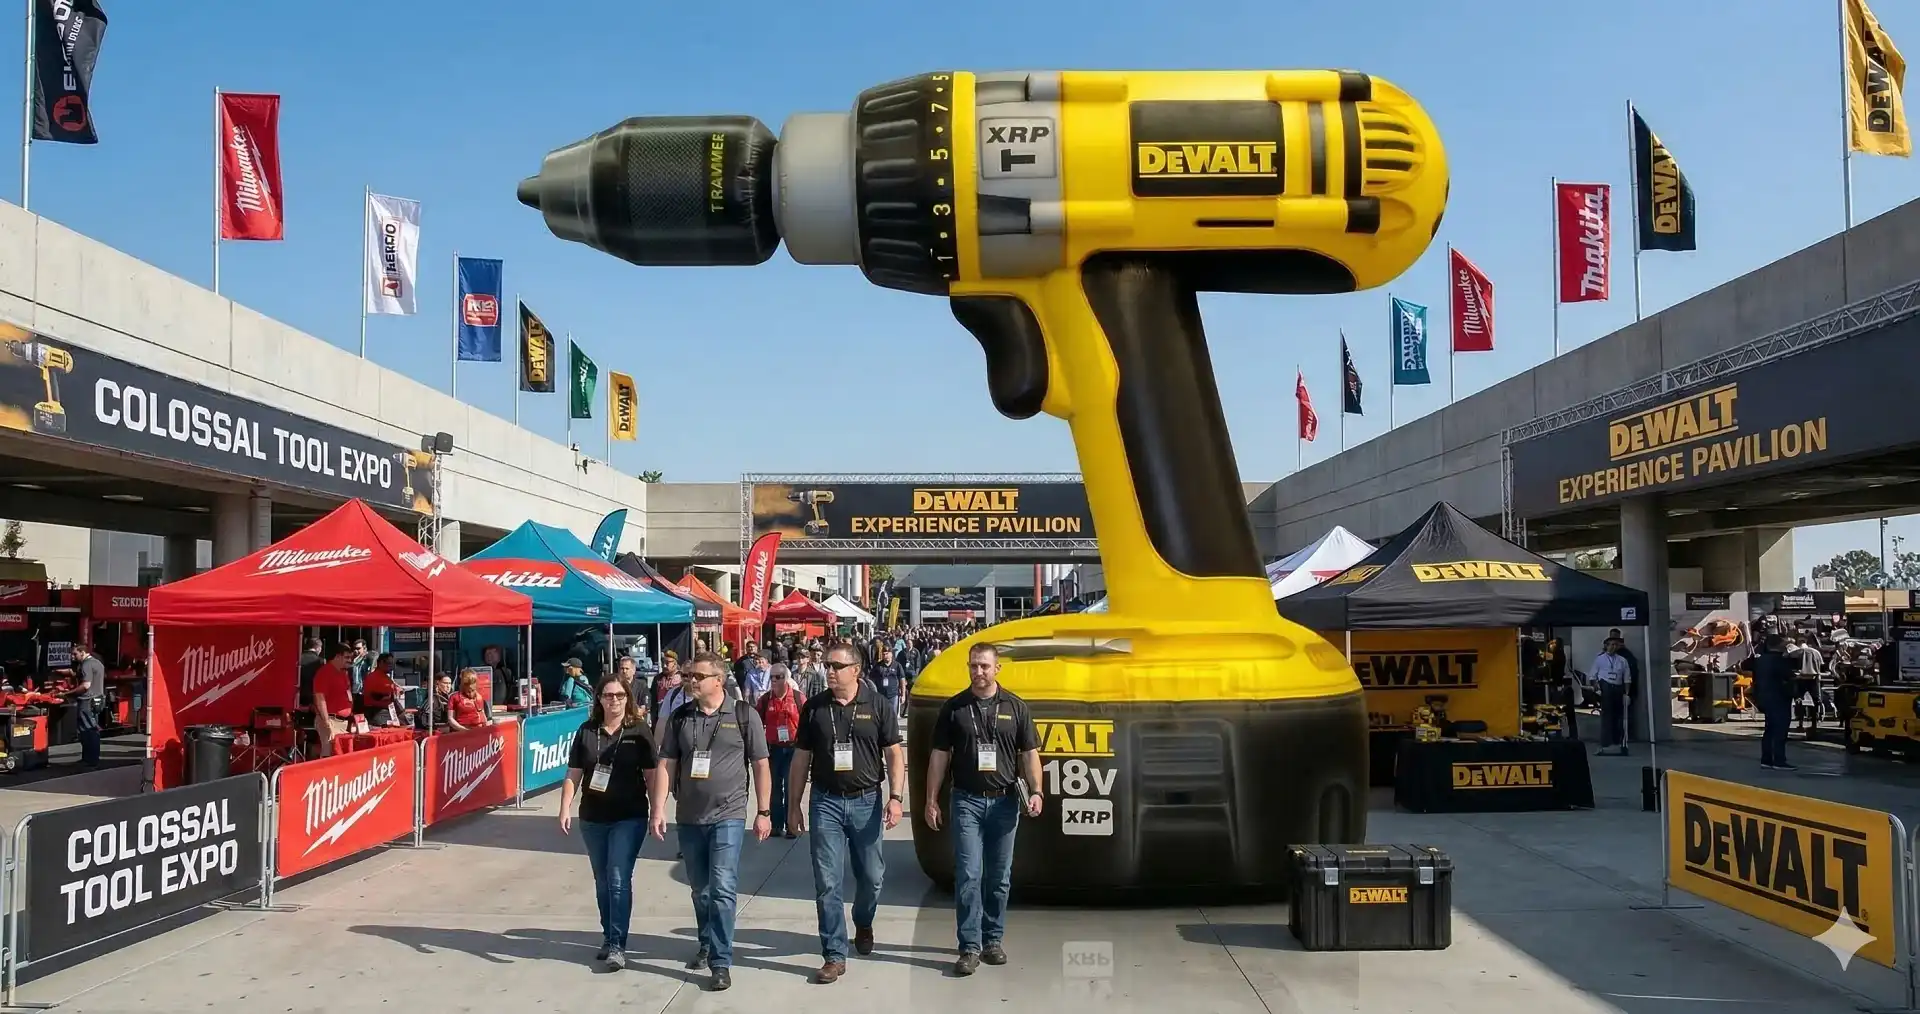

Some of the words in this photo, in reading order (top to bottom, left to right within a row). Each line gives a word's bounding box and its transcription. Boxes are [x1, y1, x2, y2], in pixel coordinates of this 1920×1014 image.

[931, 102, 949, 113] 7
[986, 126, 1050, 143] XRP
[229, 124, 264, 206] Milwaukee
[931, 148, 949, 160] 5
[933, 203, 951, 216] 3
[1458, 268, 1484, 339] Milwaukee
[95, 378, 267, 461] COLOSSAL
[273, 428, 334, 476] TOOL
[340, 446, 392, 489] EXPO
[1559, 452, 1684, 504] EXPERIENCE
[1692, 417, 1827, 476] PAVILION
[851, 517, 980, 533] EXPERIENCE
[986, 517, 1081, 533] PAVILION
[258, 545, 372, 570] Milwaukee
[177, 635, 275, 695] Milwaukee
[440, 734, 506, 795] Milwaukee
[301, 756, 397, 836] Milwaukee
[1065, 810, 1111, 824] XRP
[67, 798, 236, 872] COLOSSAL
[60, 864, 152, 925] TOOL
[161, 839, 238, 895] EXPO
